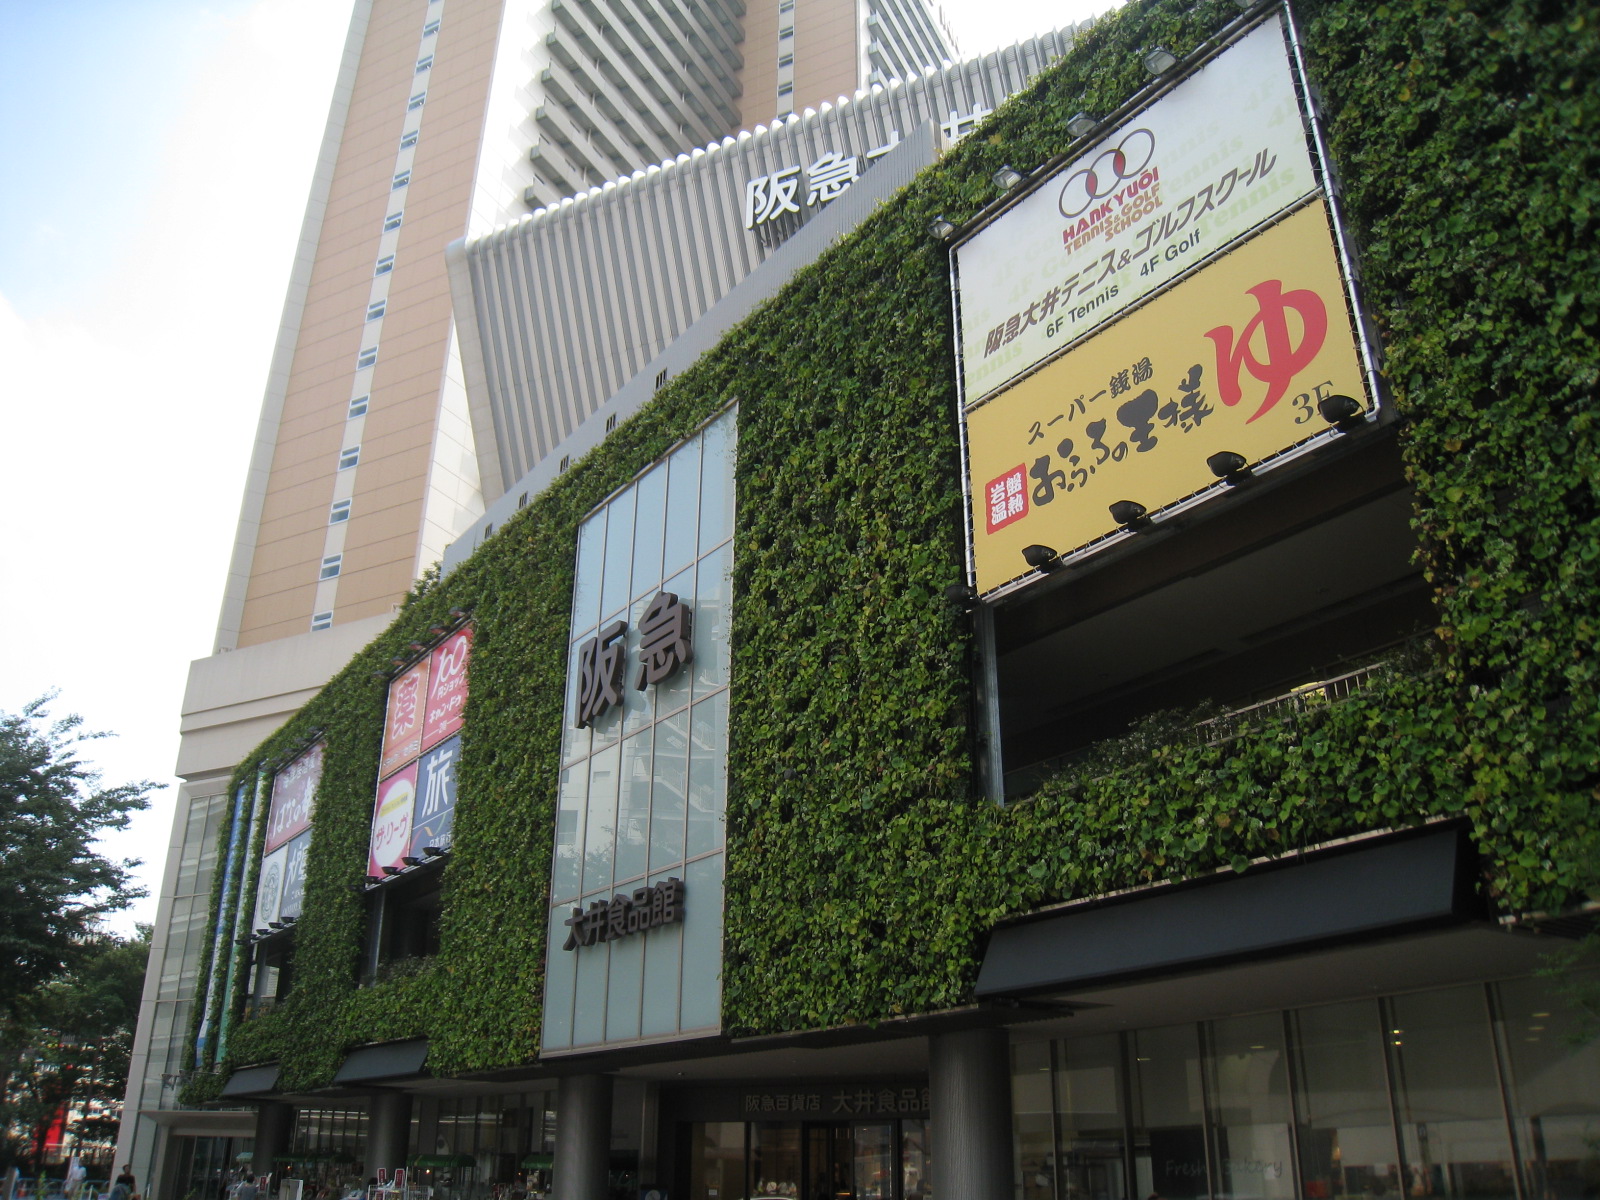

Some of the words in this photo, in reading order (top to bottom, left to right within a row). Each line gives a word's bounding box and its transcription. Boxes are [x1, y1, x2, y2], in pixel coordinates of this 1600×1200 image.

[984, 147, 1278, 359] 阪急大井テニス&ゴルフスクール
[1105, 196, 1163, 242] SCHOOL
[1046, 322, 1064, 338] 6F
[1068, 285, 1120, 324] Tennis
[1140, 254, 1160, 278] 4F
[1165, 228, 1201, 262] Golf
[1204, 279, 1328, 425] ゆ
[1028, 357, 1153, 445] スーパー銭湯
[1029, 363, 1214, 507] おふろの王様
[430, 635, 467, 700] 100
[574, 590, 694, 730] 阪急
[421, 749, 453, 819] 旅
[563, 876, 685, 951] 大井食品館
[744, 1094, 822, 1113] 阪急百貨店
[1166, 1158, 1207, 1178] Fresh
